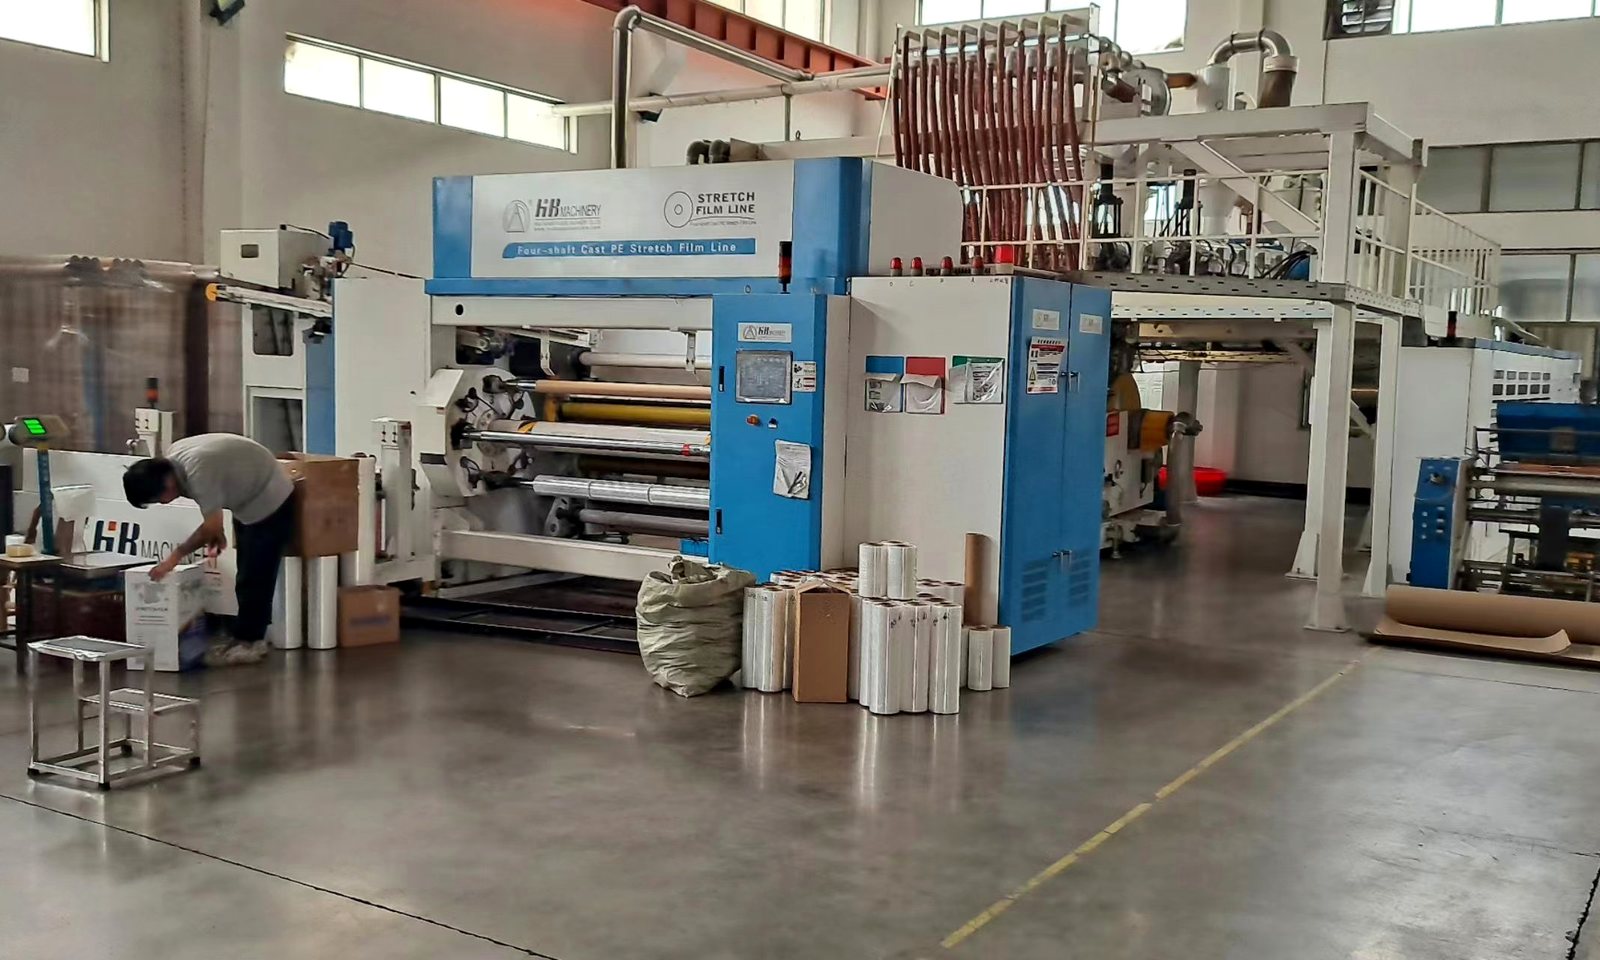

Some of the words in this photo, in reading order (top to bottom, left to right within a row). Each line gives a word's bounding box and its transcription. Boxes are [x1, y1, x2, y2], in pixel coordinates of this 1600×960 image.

[698, 192, 755, 203] STRETCH
[561, 204, 602, 217] MACHINERY
[696, 206, 723, 215] FILM
[728, 204, 755, 214] LINE
[581, 244, 606, 254] Cast
[611, 244, 624, 253] PE
[630, 243, 673, 253] Stretch
[679, 243, 704, 253] Film
[711, 242, 736, 252] Line
